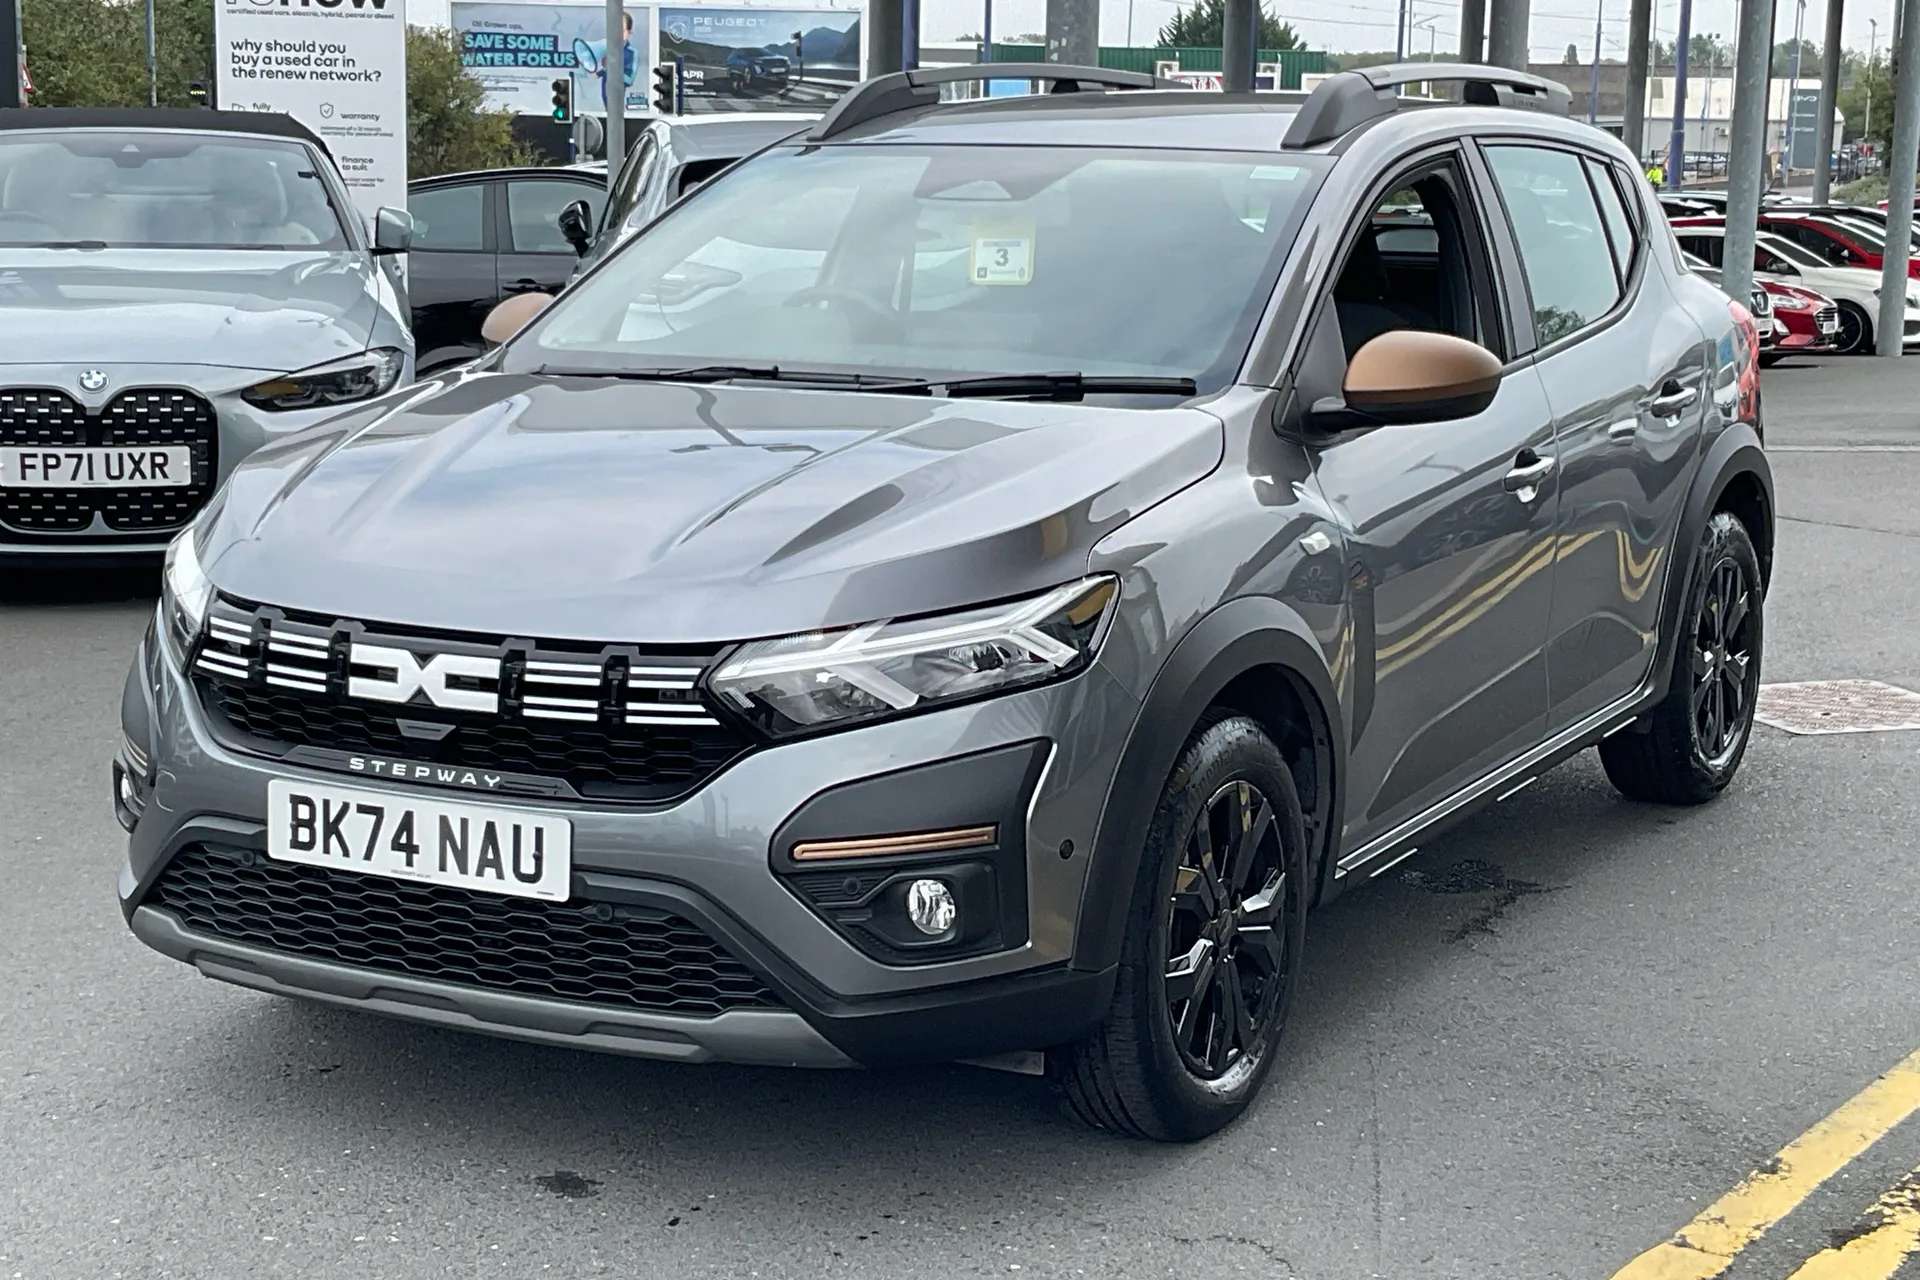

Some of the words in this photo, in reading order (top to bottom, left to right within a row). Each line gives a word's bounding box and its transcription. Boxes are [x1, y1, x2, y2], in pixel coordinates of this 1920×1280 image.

[693, 16, 766, 27] PEUGEOT
[231, 39, 262, 54] why
[265, 40, 316, 53] should
[319, 43, 346, 55] you
[464, 34, 505, 49] SAVE
[507, 35, 554, 50] SOME
[231, 52, 259, 67] buy
[262, 56, 272, 65] a
[275, 54, 311, 66] used
[314, 57, 339, 67] car
[342, 55, 356, 67] in
[462, 52, 515, 66] WATER
[517, 53, 552, 66] FOR
[553, 53, 576, 66] US
[231, 66, 257, 78] the
[260, 69, 307, 80] renew
[310, 69, 382, 82] network?
[341, 113, 380, 121] warranty
[342, 156, 374, 164] finance
[995, 248, 1009, 267] 3
[19, 453, 94, 481] FP71
[104, 452, 169, 480] UXR
[349, 757, 501, 788] STEPWAY
[288, 793, 421, 868] BK74
[437, 814, 545, 885] NAU
